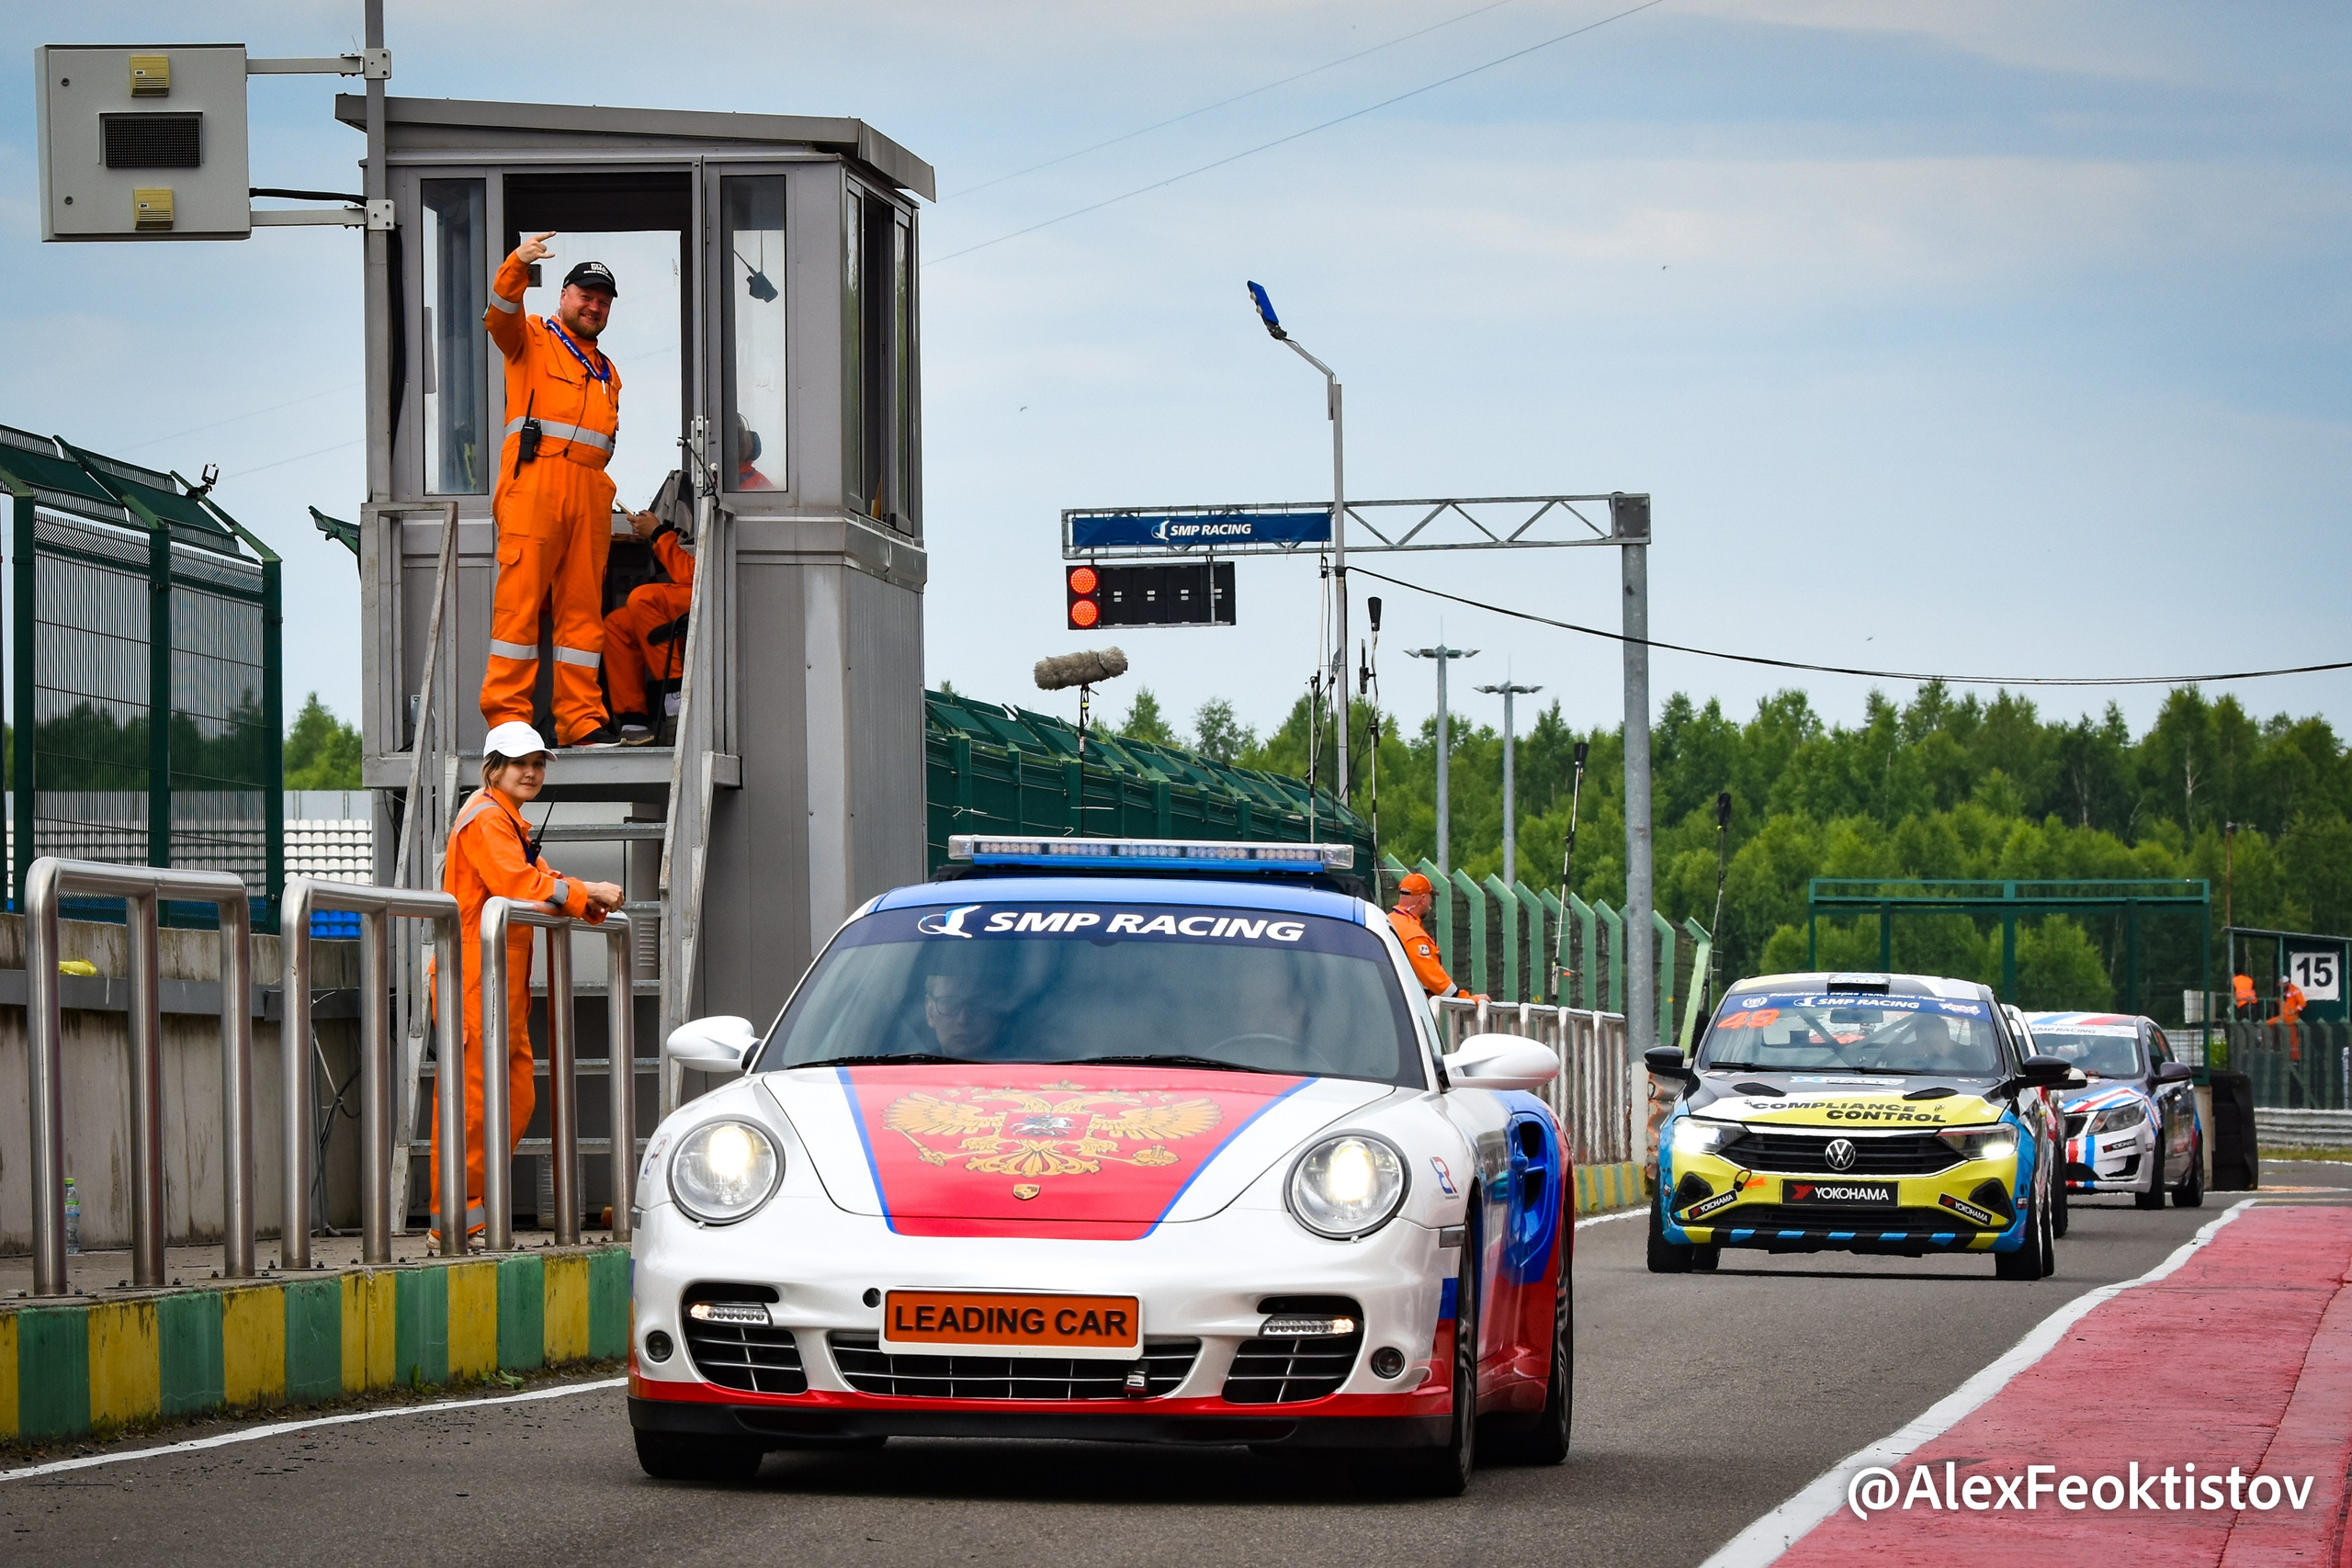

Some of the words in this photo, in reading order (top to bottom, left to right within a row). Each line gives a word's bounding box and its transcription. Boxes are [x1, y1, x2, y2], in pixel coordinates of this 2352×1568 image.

[1170, 525, 1200, 536] SMP
[1202, 523, 1251, 536] RACING
[984, 912, 1101, 932] SMP
[1105, 913, 1306, 942] RACING
[2296, 956, 2334, 987] 15
[1816, 998, 1855, 1007] SMP
[1856, 998, 1920, 1009] RACING
[1717, 1009, 1781, 1030] 49
[1751, 1101, 1917, 1112] COMPLIANCE
[1826, 1110, 1947, 1122] CONTROL
[1700, 1194, 1734, 1213] YOKOHAMA
[1815, 1187, 1889, 1201] YOKOHAMA
[1954, 1201, 1988, 1222] YOKOHAMA
[895, 1305, 1045, 1334] LEADING
[1055, 1308, 1127, 1337] CAR
